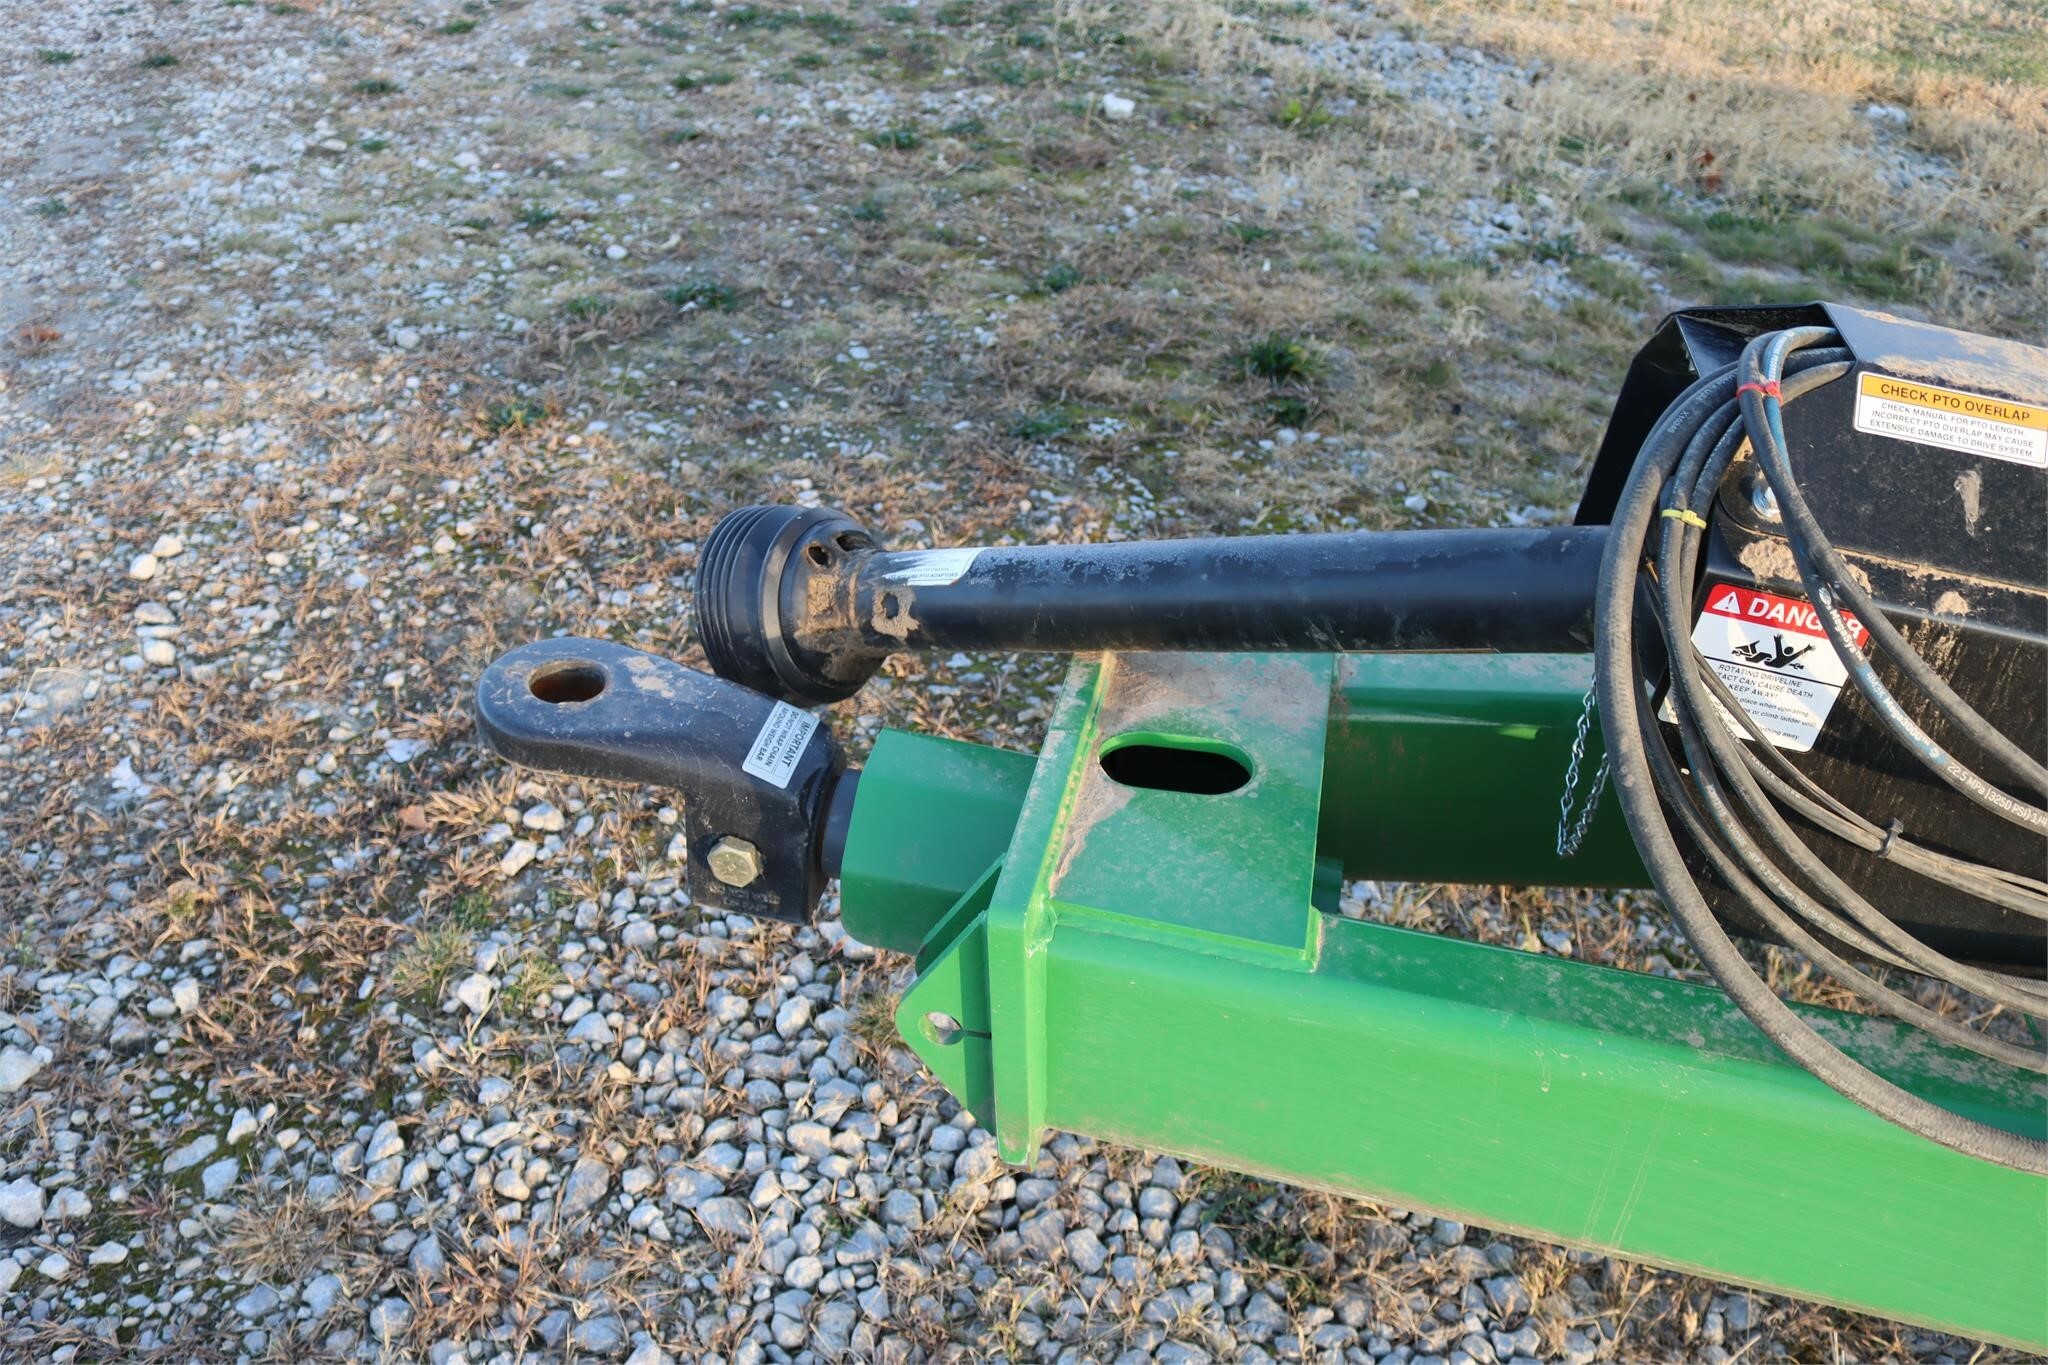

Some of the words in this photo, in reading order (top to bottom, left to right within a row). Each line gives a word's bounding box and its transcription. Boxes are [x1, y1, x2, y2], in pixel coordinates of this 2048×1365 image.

[1880, 384, 1928, 402] CHECK
[1933, 394, 1960, 408] PTO
[1964, 400, 2030, 422] OVERLAP
[1881, 402, 1910, 414] CHECK
[1913, 409, 1948, 422] MANUAL
[1951, 416, 1969, 426] FOR
[1970, 420, 1988, 430] PTO
[1870, 420, 1917, 435] EXTENSIVE
[1918, 429, 1953, 442] DAMAGE
[1958, 436, 1969, 445] TO
[1970, 440, 1996, 450] DRIVE
[1998, 444, 2032, 457] SYSTEM
[1872, 410, 1921, 425] INCORRECT
[1923, 420, 1940, 429] PTO
[1942, 424, 1982, 438] OVERLAP
[1984, 432, 2002, 442] MAY
[2005, 436, 2034, 448] CAUSE
[1747, 597, 1864, 639] DANGR
[1717, 672, 1739, 681] TACT
[1739, 678, 1757, 686] CAN
[1758, 681, 1785, 692] CAUSE
[1786, 688, 1814, 698] DEATH
[1718, 664, 1760, 678] ROTATING
[1760, 672, 1802, 688] DRIVELINE
[1728, 684, 1750, 693] KEEP
[790, 711, 799, 720] DO
[1740, 697, 1758, 706] place
[1759, 702, 1777, 710] when
[1778, 706, 1809, 718] operating
[1780, 715, 1800, 724] ladder
[784, 718, 794, 730] NOT
[776, 729, 788, 746] WRAP
[781, 721, 811, 768] IMPORTANT
[764, 746, 780, 767] CHAIN
[1947, 763, 1966, 782] 22.5
[1967, 775, 1986, 795] MPa
